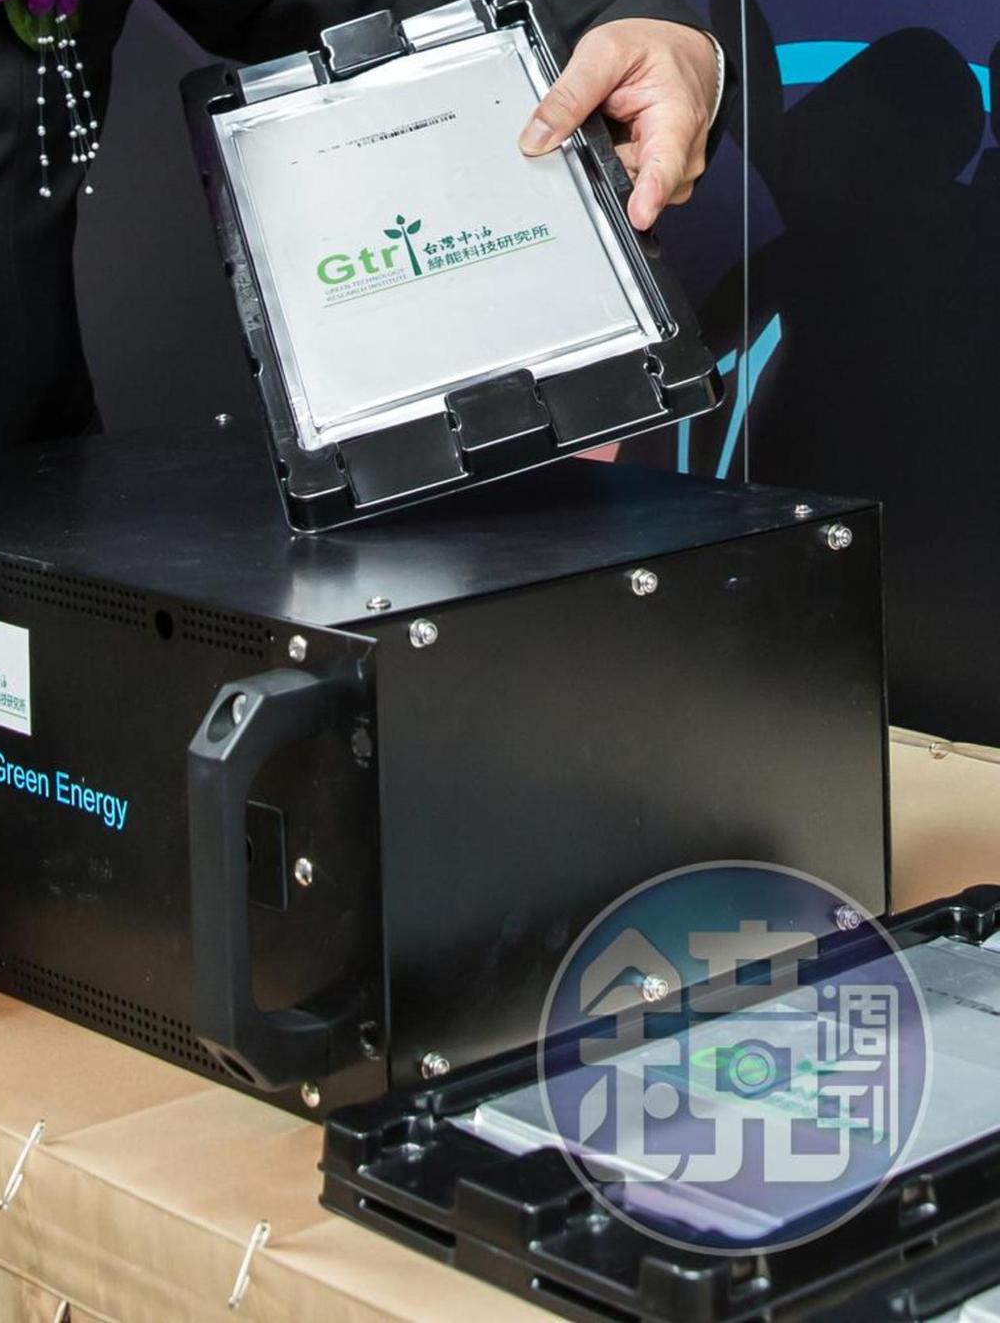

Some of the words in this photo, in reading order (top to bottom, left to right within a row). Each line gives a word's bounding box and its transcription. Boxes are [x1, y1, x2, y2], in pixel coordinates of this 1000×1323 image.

[427, 223, 549, 271] 綠能科技研究所
[55, 771, 129, 830] Energy
